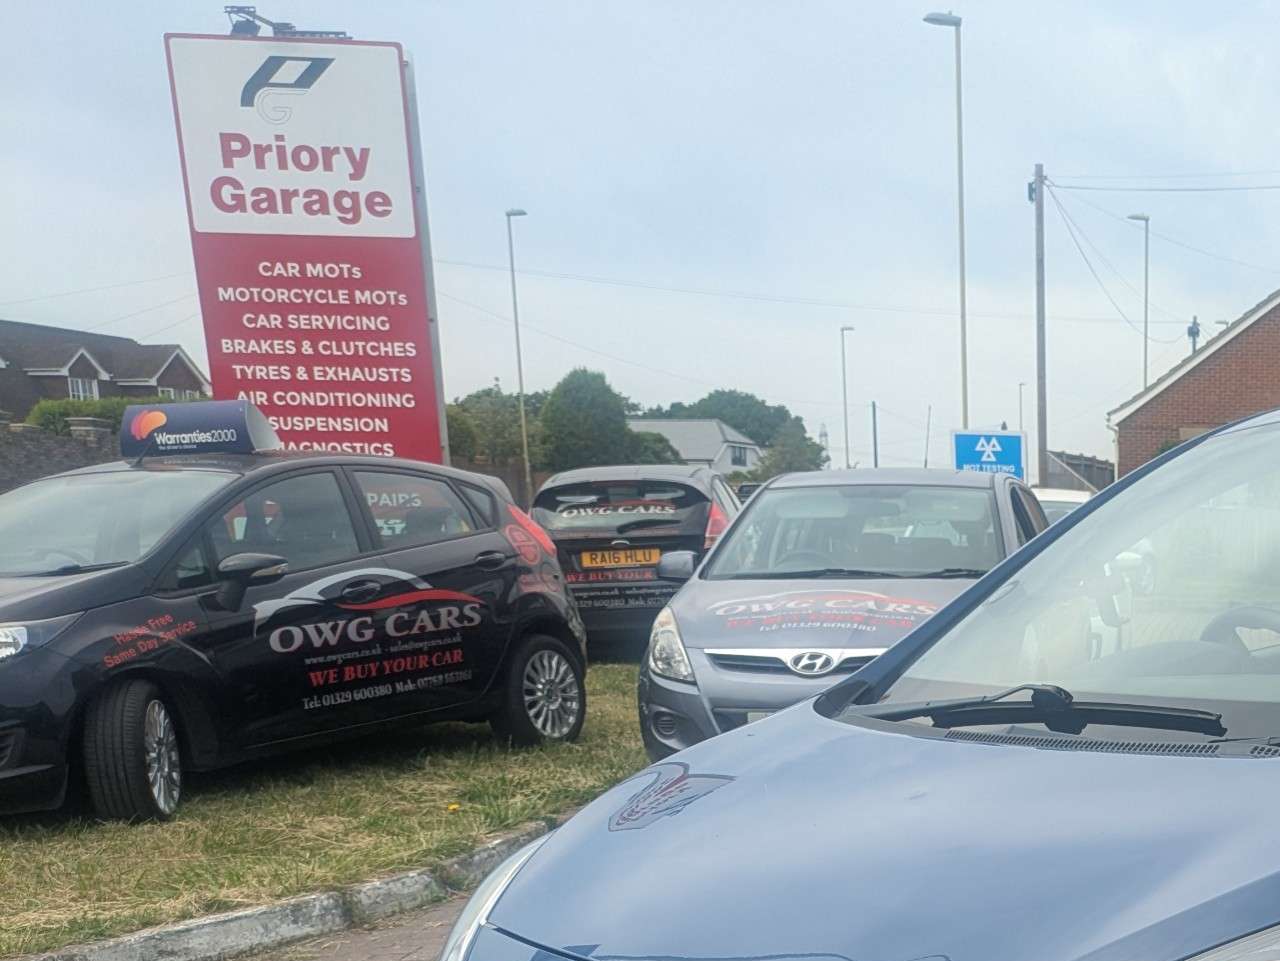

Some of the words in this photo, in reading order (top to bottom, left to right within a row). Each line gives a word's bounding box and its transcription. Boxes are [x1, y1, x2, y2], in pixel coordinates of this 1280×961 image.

[219, 132, 370, 181] Priory
[210, 176, 392, 225] Garage
[259, 262, 300, 277] CAR
[306, 263, 362, 279] MOTs
[218, 287, 350, 304] MOTORCYCLE
[355, 290, 407, 306] MOTs
[243, 314, 283, 329] CAR
[288, 315, 390, 331] SERVICING
[221, 339, 296, 354] BRAKES
[301, 340, 314, 355] &
[318, 341, 417, 357] CLUTCHES
[232, 366, 291, 380] TYRES
[296, 366, 309, 381] &
[313, 367, 412, 383] EXHAUSTS
[237, 391, 268, 405] AIR
[273, 392, 415, 408] CONDITIONING
[267, 416, 389, 432] SUSPENSION
[154, 429, 237, 445] Warranties2000
[561, 505, 612, 518] OWG
[618, 504, 677, 515] CARS
[589, 551, 621, 564] RA16
[625, 550, 652, 563] HLU
[825, 599, 938, 615] CARS
[148, 613, 174, 630] Free
[269, 617, 375, 652] OWG
[385, 604, 482, 636] CARS
[104, 648, 136, 668] Same
[138, 638, 159, 653] Day
[160, 620, 197, 642] Service
[308, 668, 338, 687] WE
[343, 661, 380, 681] BUY
[383, 654, 429, 674] YOUR
[432, 648, 464, 667] CAR
[322, 691, 352, 707] 01329
[353, 683, 393, 701] 600380
